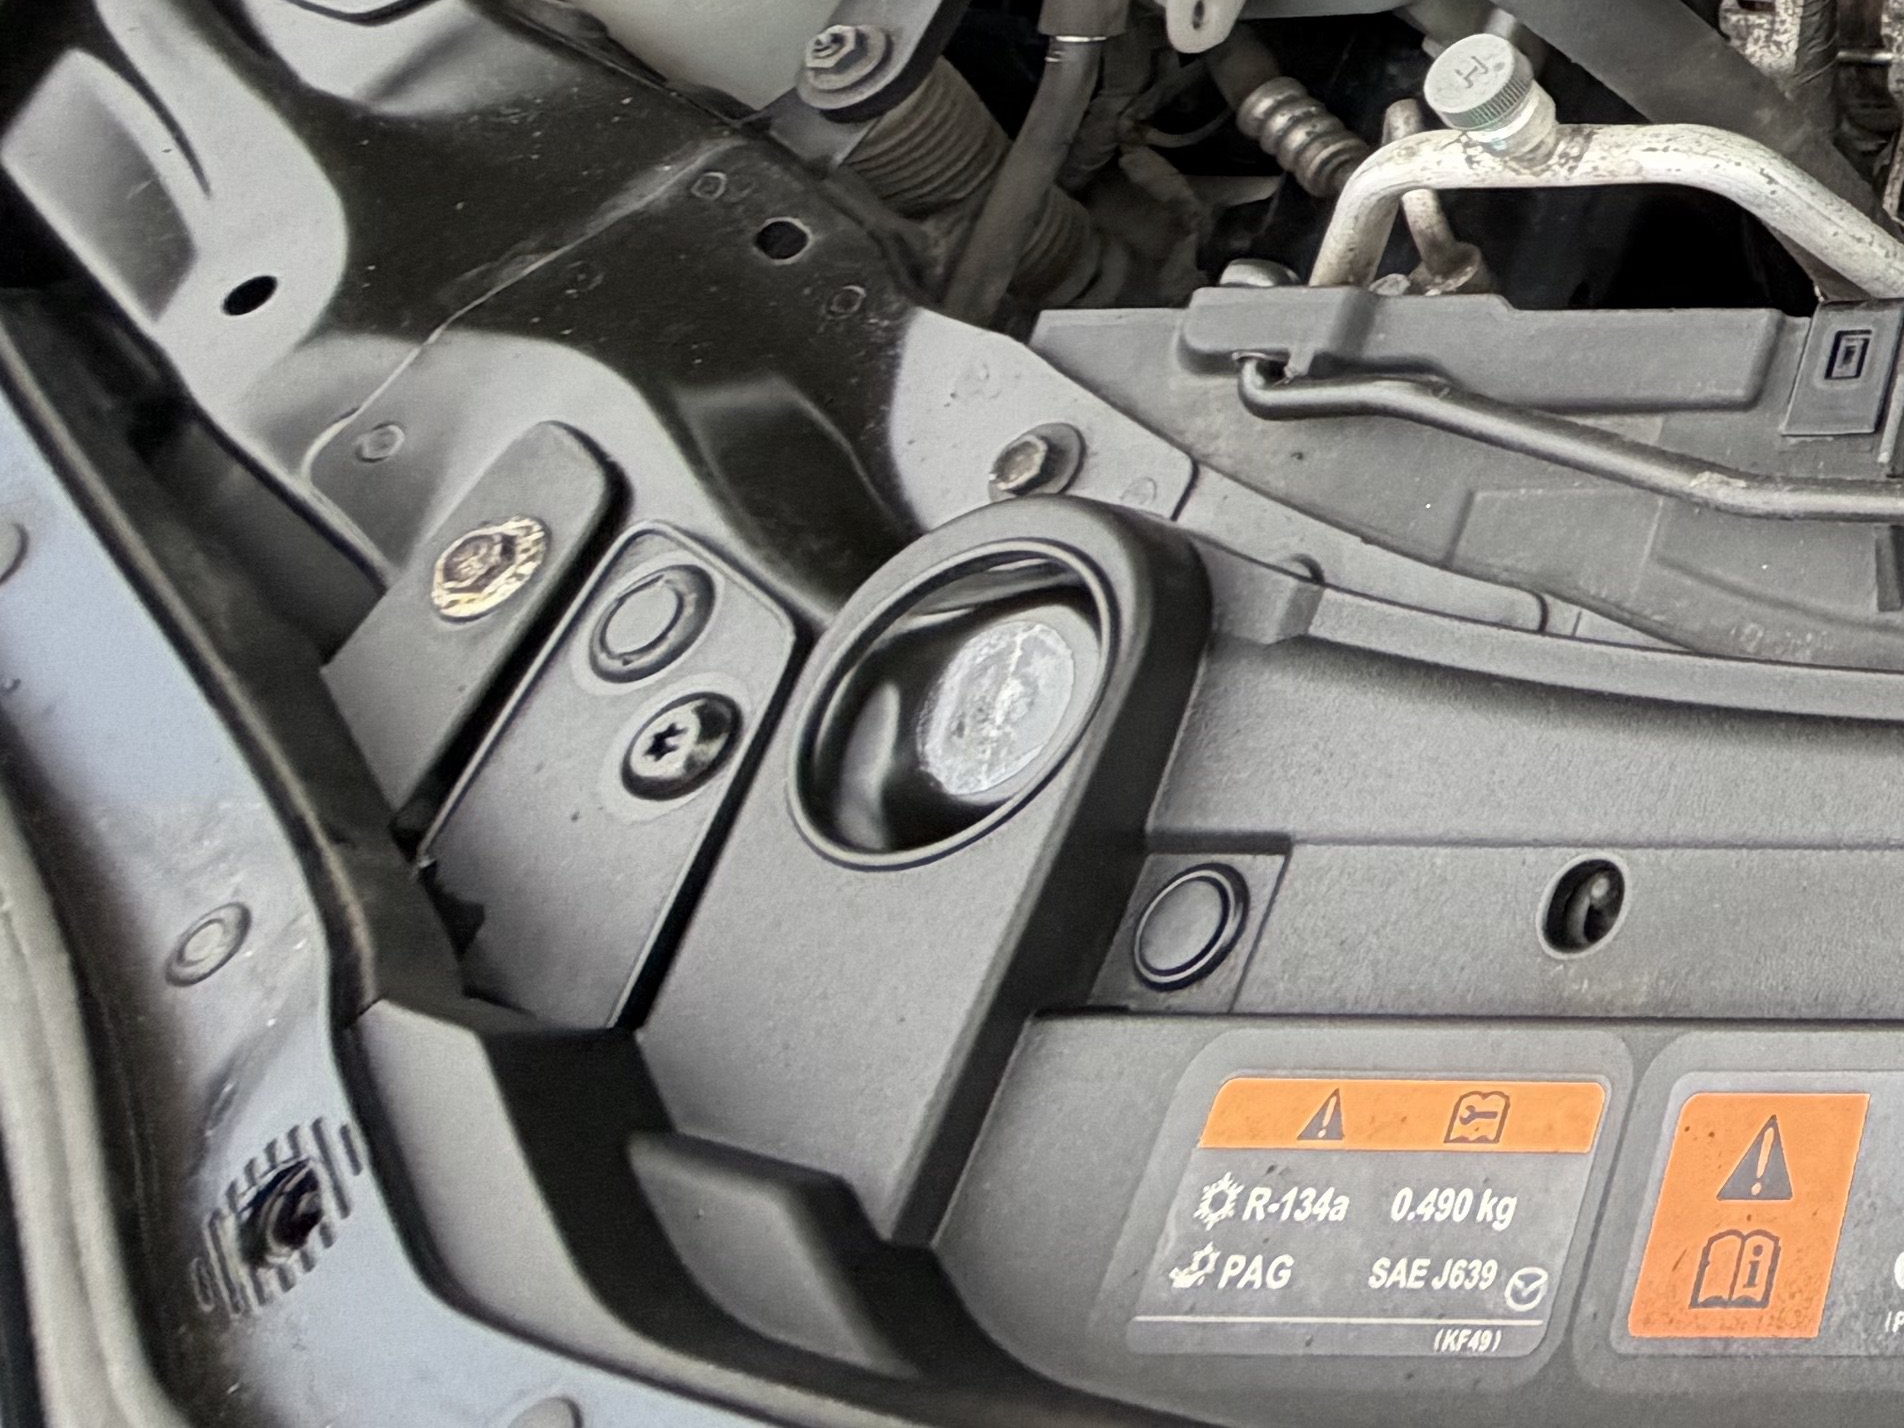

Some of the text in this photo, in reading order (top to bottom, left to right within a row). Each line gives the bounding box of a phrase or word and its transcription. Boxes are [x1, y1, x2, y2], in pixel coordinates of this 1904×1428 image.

[1242, 1186, 1518, 1232] R-134a 0.490 kg
[1218, 1254, 1499, 1291] PAG SAE J639
[1433, 1328, 1502, 1354] (KF49)
